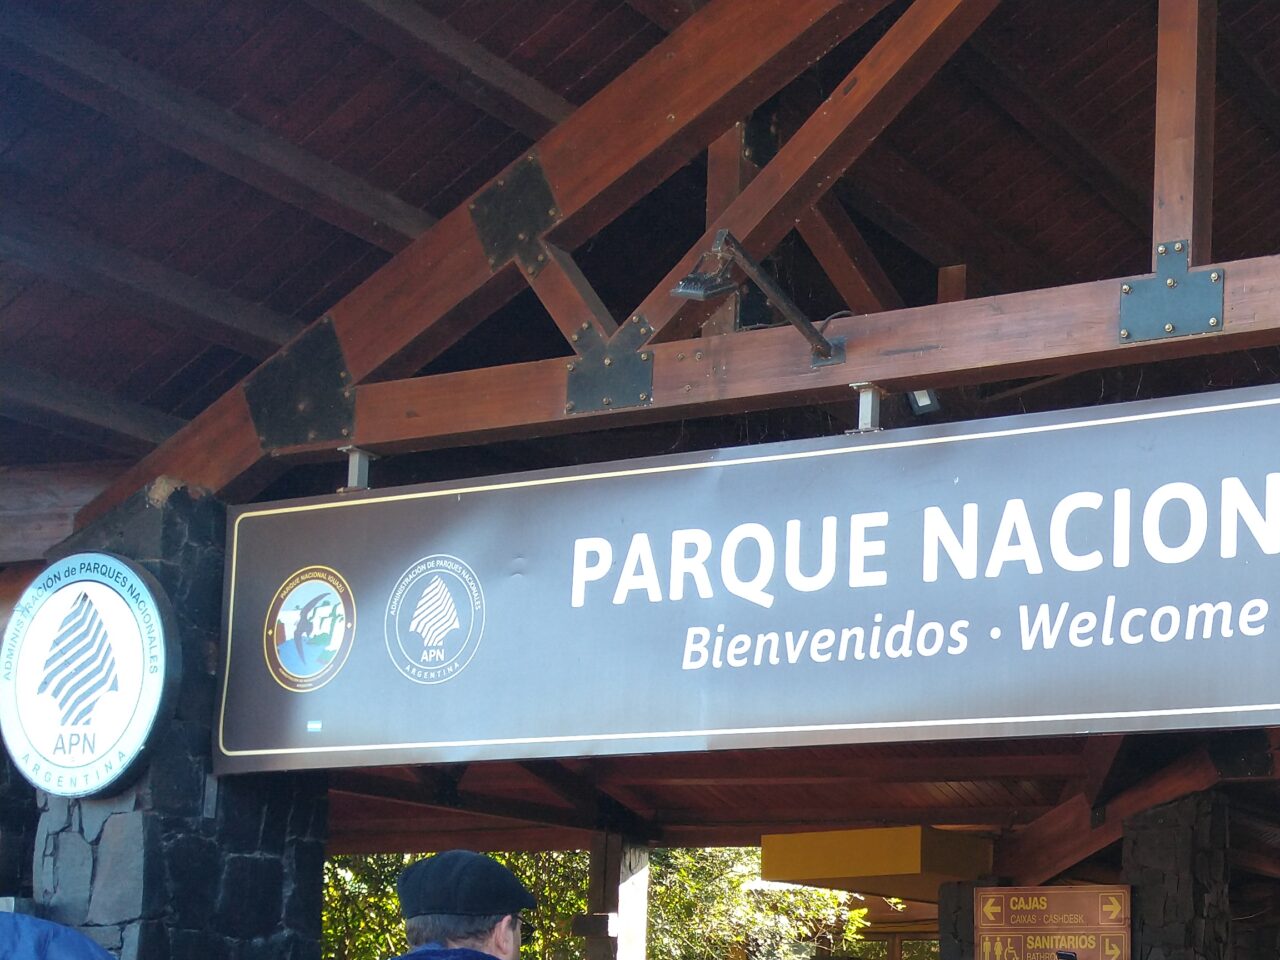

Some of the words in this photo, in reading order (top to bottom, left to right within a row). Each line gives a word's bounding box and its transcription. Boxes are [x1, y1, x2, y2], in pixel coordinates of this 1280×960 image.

[571, 511, 889, 609] PARQUE
[427, 560, 436, 569] DE
[436, 559, 462, 574] PARQUES
[461, 569, 481, 610] NACIONALES
[3, 572, 61, 681] ADMINISTRACIÓN
[64, 566, 77, 579] de
[79, 562, 128, 587] PARQUES
[127, 583, 158, 674] NACIONALES
[682, 609, 970, 670] Bienvenidos
[1018, 595, 1269, 651] Welcome
[420, 648, 445, 662] APN
[405, 662, 460, 679] ARGENTINA
[53, 733, 96, 755] APN
[22, 750, 125, 787] ARGENTINA
[1010, 897, 1047, 910] CAJAS
[1010, 914, 1037, 923] CAIXAS
[1043, 914, 1084, 924] CASHDESK
[1026, 935, 1096, 949] SANITARIOS
